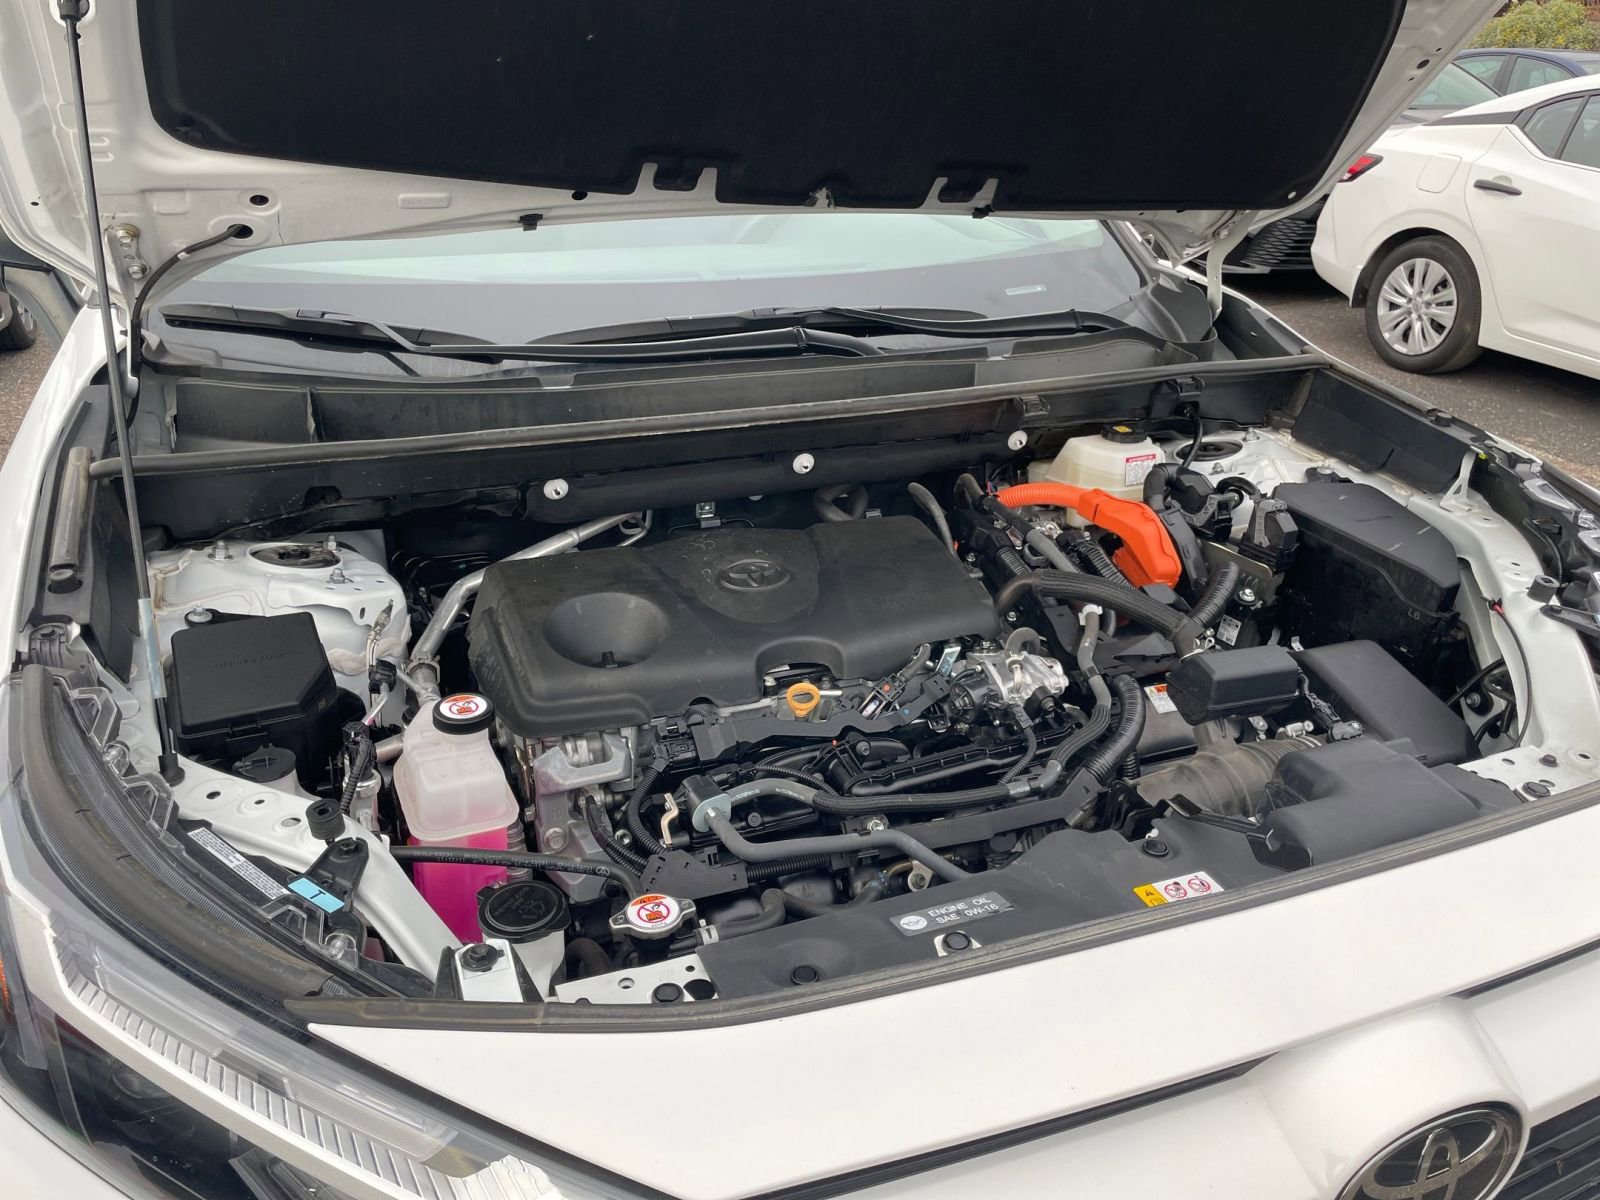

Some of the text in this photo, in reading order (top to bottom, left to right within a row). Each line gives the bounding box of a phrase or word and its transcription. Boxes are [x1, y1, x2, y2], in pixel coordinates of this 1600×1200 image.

[309, 889, 326, 900] T
[928, 898, 992, 917] ENGINE OIL
[935, 903, 999, 924] SAE 0W-16
